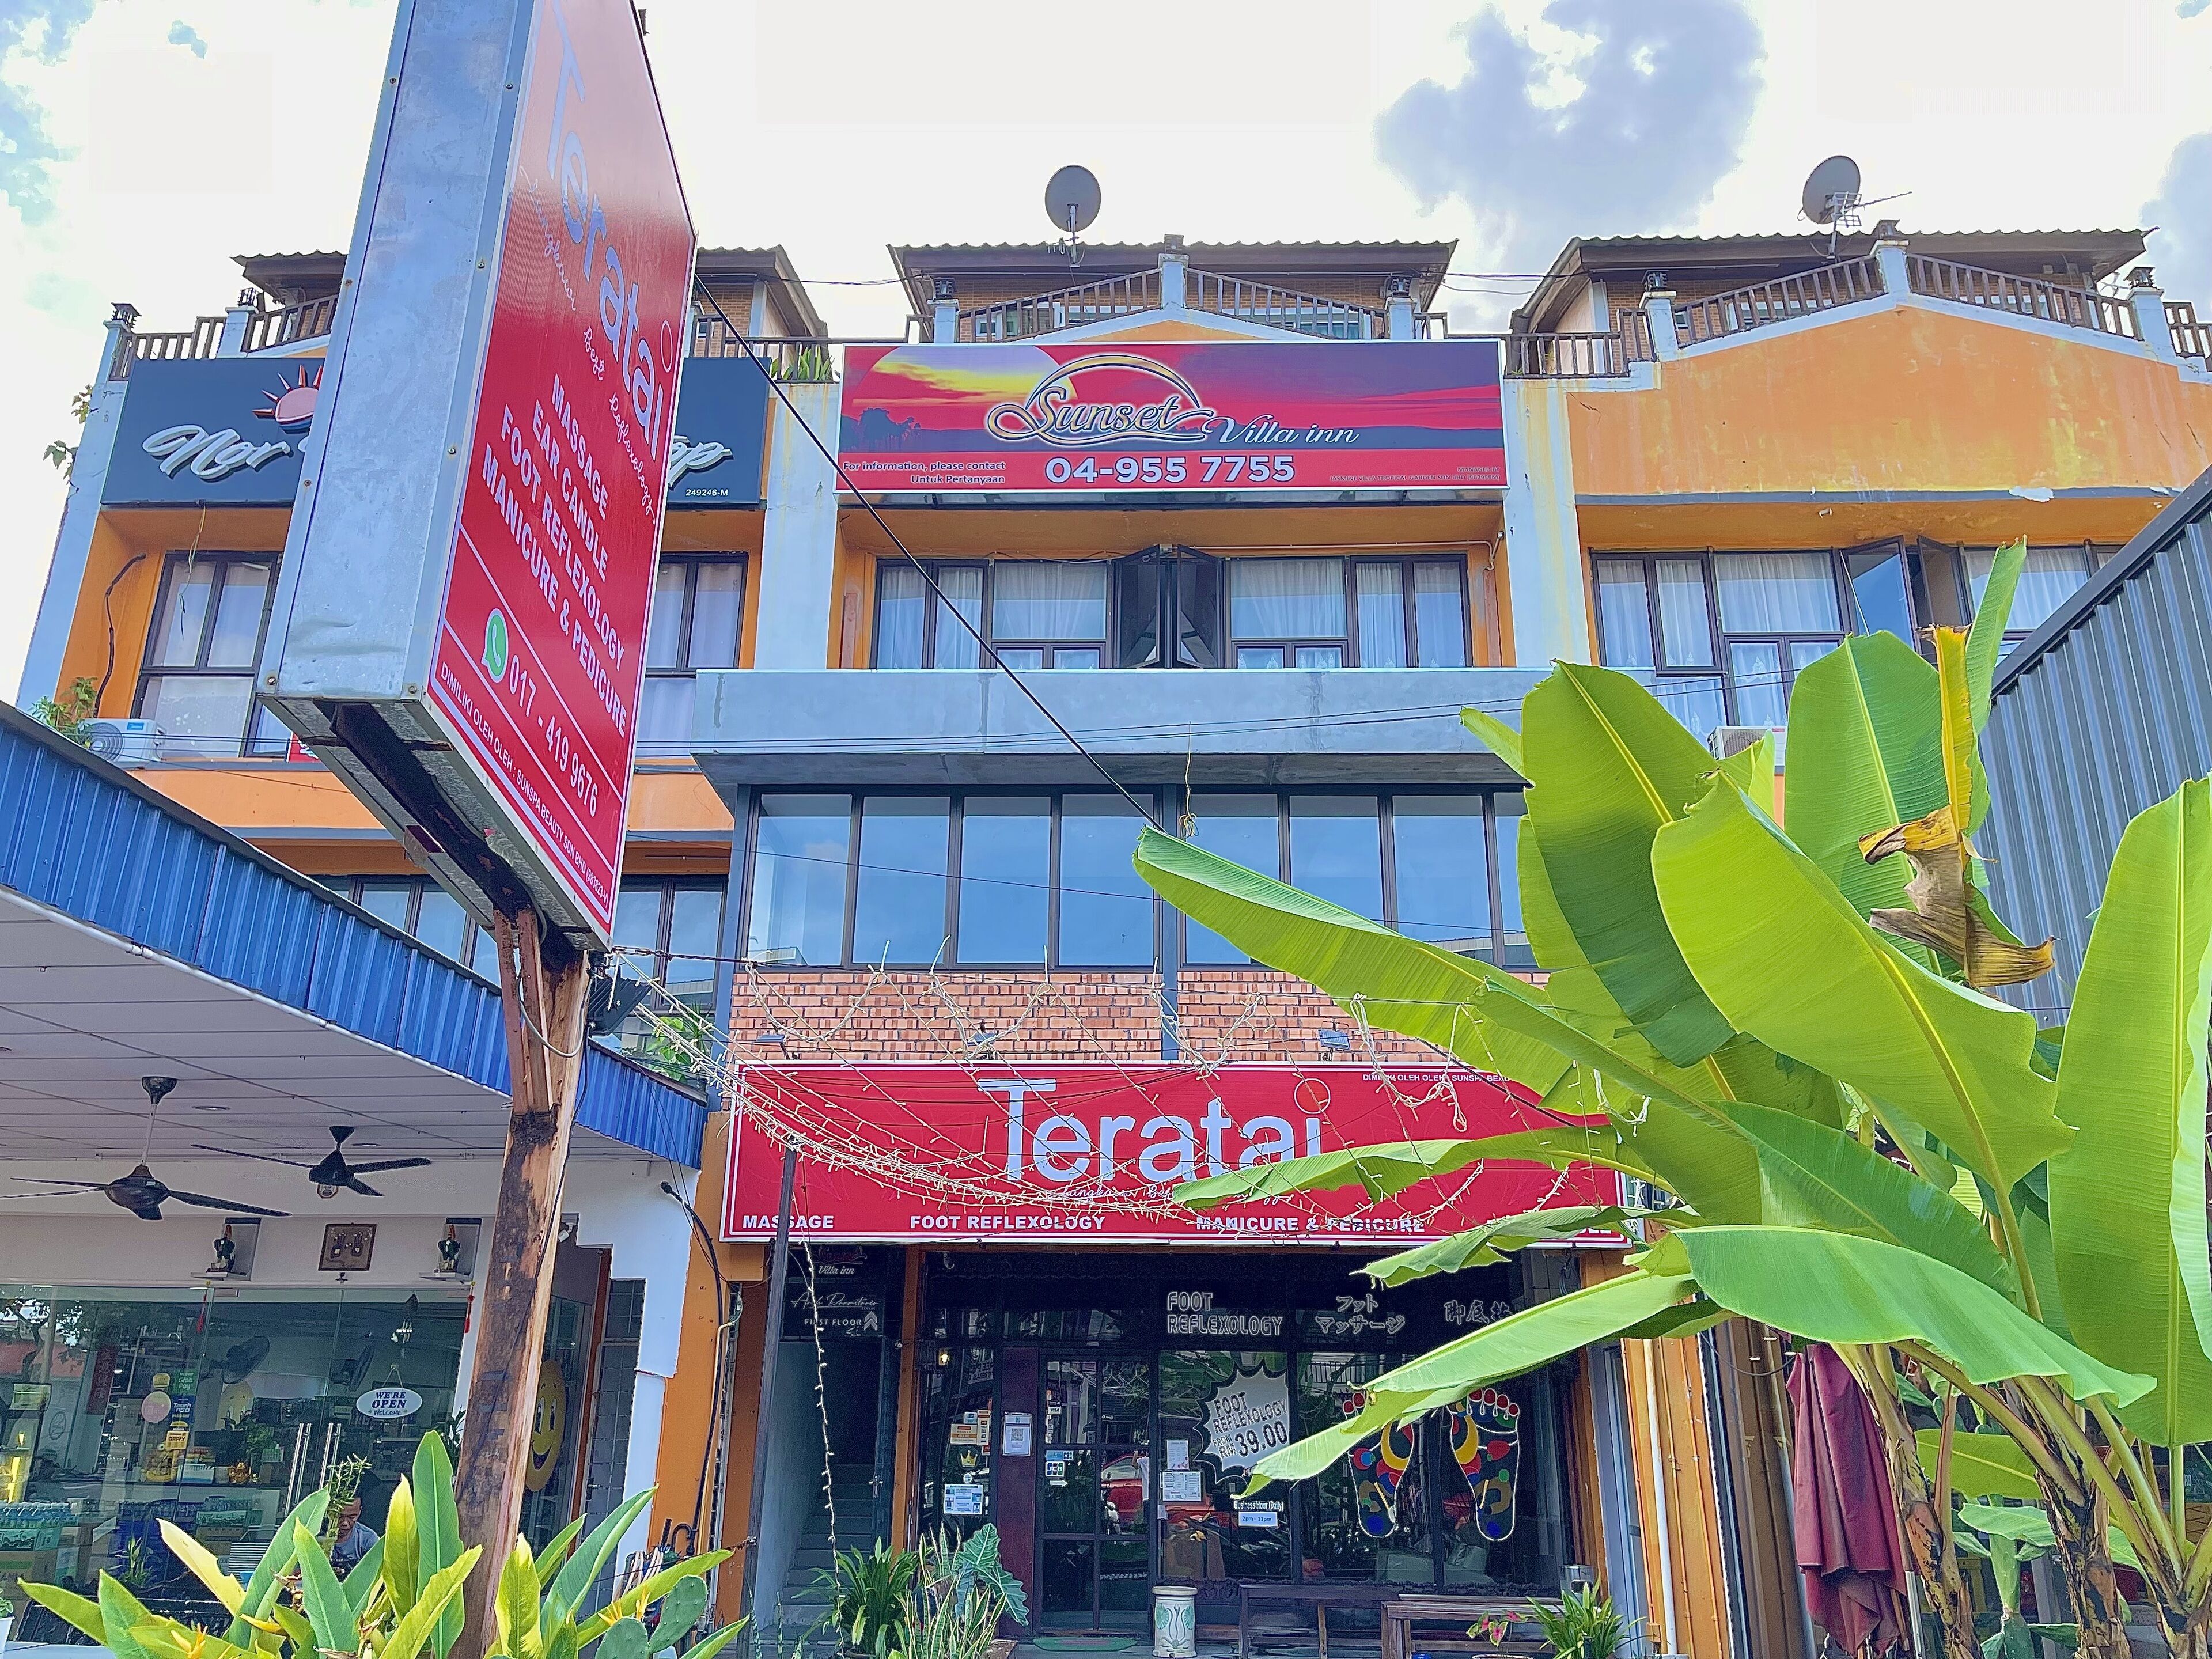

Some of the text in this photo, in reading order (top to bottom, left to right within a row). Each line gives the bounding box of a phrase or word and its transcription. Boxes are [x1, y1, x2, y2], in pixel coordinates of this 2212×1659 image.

[584, 325, 605, 381] Best
[609, 392, 656, 527] Reflexology
[1202, 414, 1360, 444] Villa inn
[142, 425, 291, 479] Nor
[551, 372, 609, 521] MASSAGE
[843, 461, 1006, 472] For information, please contact
[911, 475, 1005, 485] Untuk Pertanyaan
[1045, 455, 1295, 484] 04-955 7755
[531, 398, 609, 584] EAR CANDLE
[685, 488, 729, 497] 249246-M
[501, 403, 625, 672] FOOT REFLEXOLOGY
[482, 441, 628, 740] MANICURE & PEDICURE
[509, 654, 537, 718] 017
[545, 715, 569, 773] 419
[570, 752, 599, 818] 9676
[441, 660, 473, 717] DIMILIKI
[473, 707, 494, 746] OLEH
[494, 737, 513, 773] OLEH
[516, 770, 540, 813] SUNSPA
[540, 803, 564, 843] BEAUTY
[563, 835, 575, 860] SDN
[575, 851, 586, 875] BHD
[977, 1077, 1330, 1183] Teratai
[910, 1215, 1105, 1230] FOOT REFLEXOLOGY
[1196, 1217, 1425, 1232] MANICURE & PEDICURE
[818, 1266, 855, 1274] Villa inn
[1167, 1291, 1213, 1312] FOOT
[1336, 1293, 1378, 1313] フット
[1167, 1315, 1283, 1336] REFLEXOLOGY
[1315, 1315, 1406, 1335] マッサージ
[372, 1400, 407, 1408] OPEN
[1212, 1398, 1286, 1435] REFLEXOLOGY
[1214, 1391, 1248, 1418] FOOT
[1212, 1433, 1232, 1448] FROM
[1218, 1442, 1237, 1459] RM
[1234, 1420, 1287, 1457] 39.00
[1234, 1500, 1284, 1512] Business Hour (Daily)
